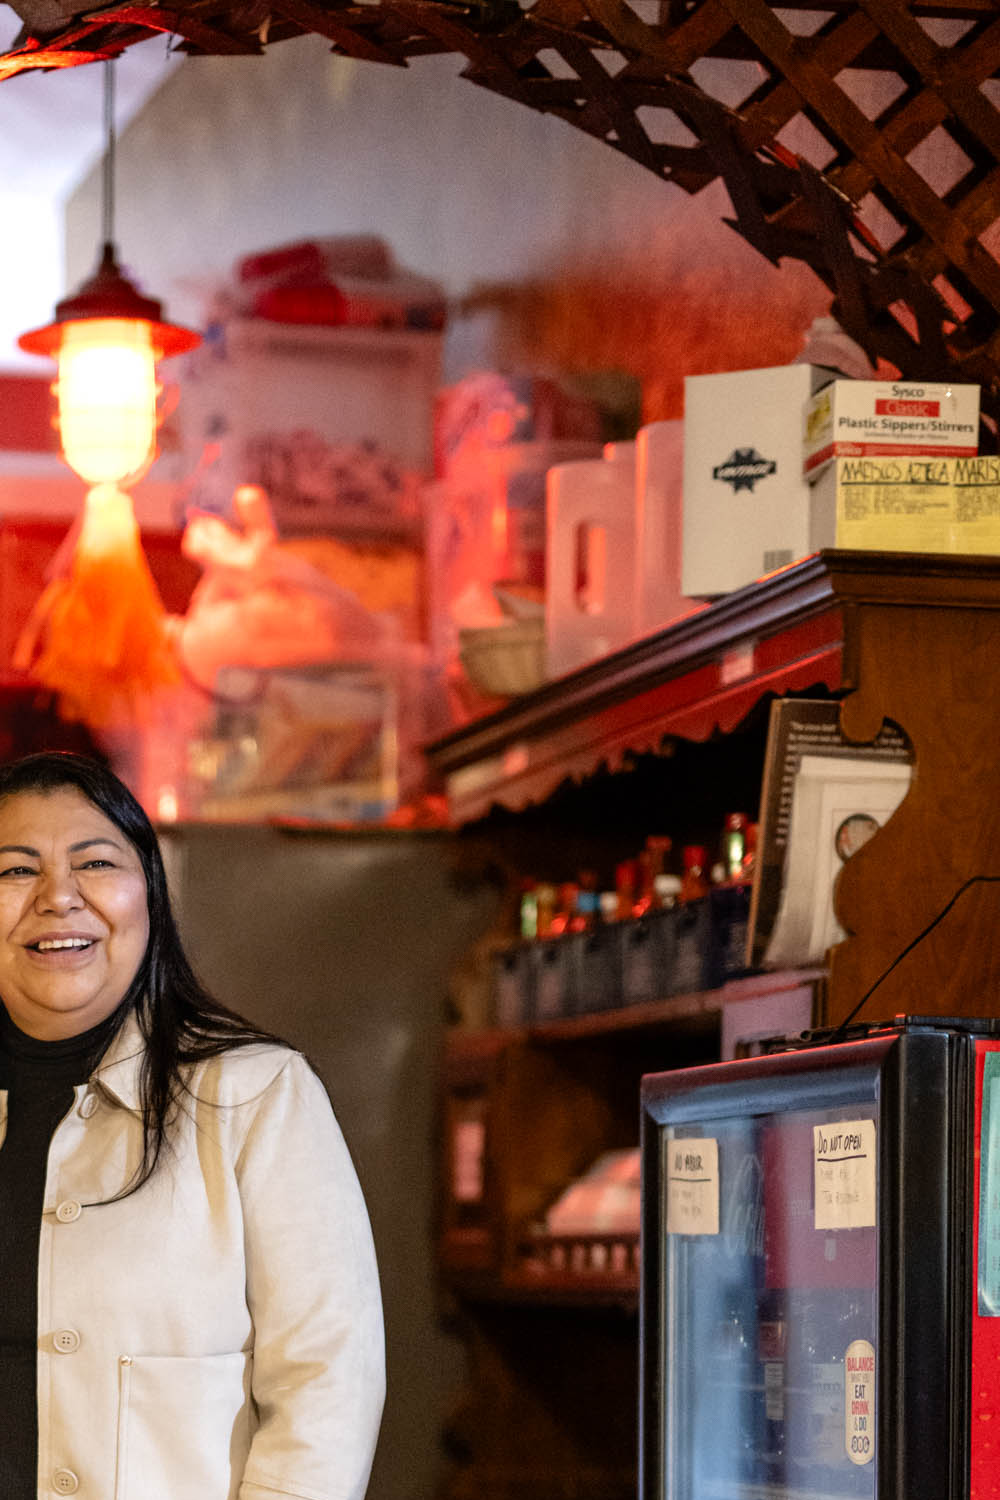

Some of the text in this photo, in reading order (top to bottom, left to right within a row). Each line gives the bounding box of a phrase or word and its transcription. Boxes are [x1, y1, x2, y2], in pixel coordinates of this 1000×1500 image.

[891, 385, 925, 399] Sysco
[838, 417, 974, 433] Plastic Sippers/Stirrers
[907, 461, 949, 484] AZTECA
[953, 458, 1000, 483] MARIS
[830, 1134, 843, 1153] NOT
[844, 1132, 862, 1151] OPEN
[847, 1357, 874, 1372] BALANCE
[854, 1384, 866, 1399] EAT
[851, 1400, 869, 1416] DRINK
